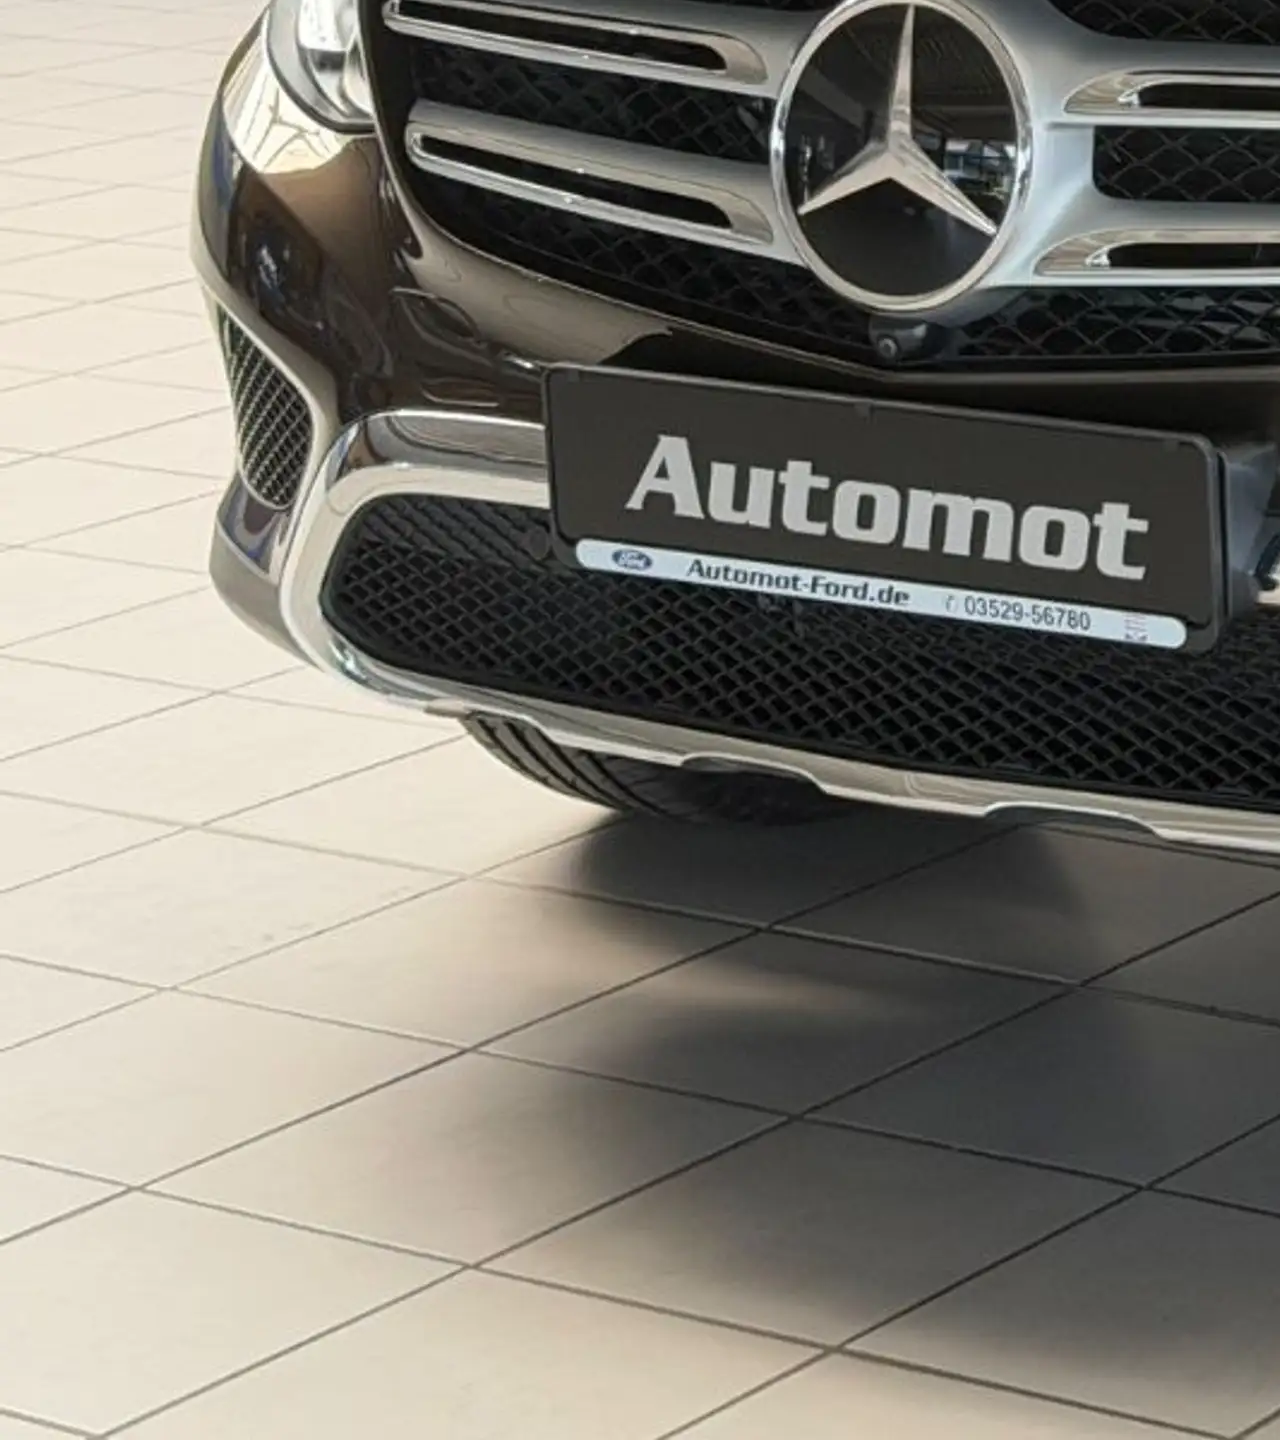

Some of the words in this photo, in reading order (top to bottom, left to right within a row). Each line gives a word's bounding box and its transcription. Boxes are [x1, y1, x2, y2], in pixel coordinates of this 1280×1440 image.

[626, 434, 1149, 580] Automot
[687, 559, 910, 606] Automot-Ford.de
[964, 595, 1091, 631] 03529-56780
